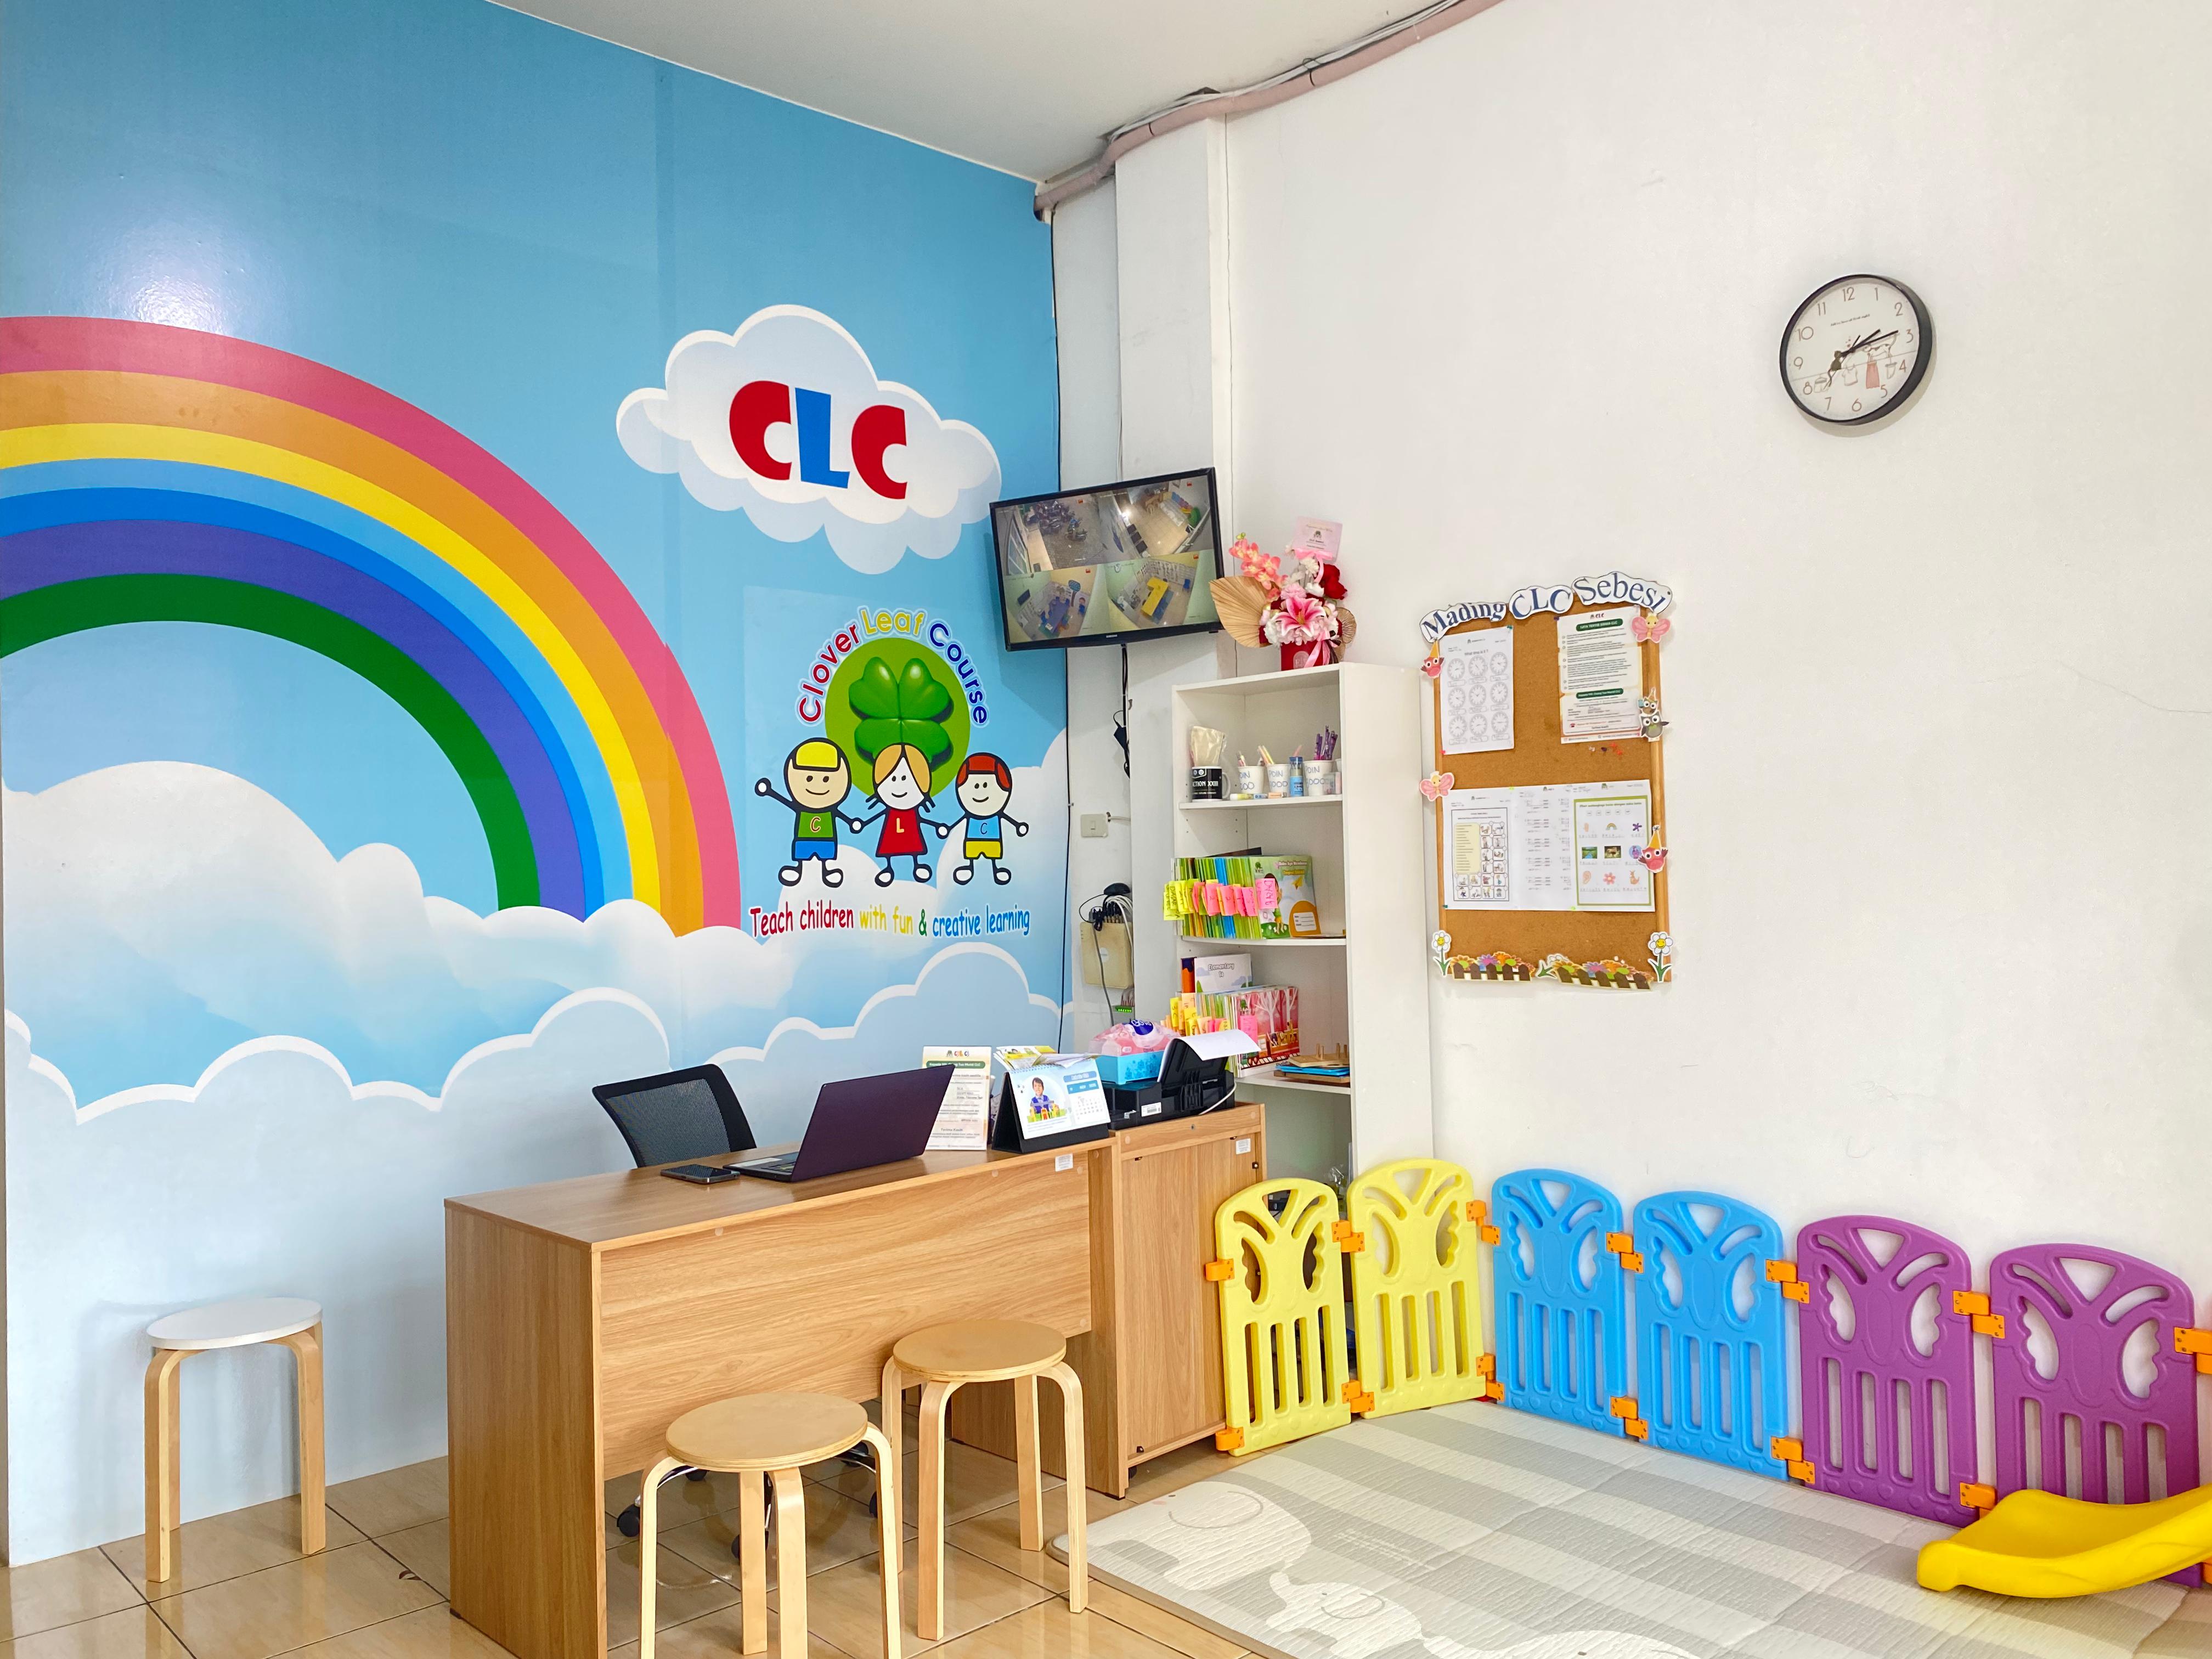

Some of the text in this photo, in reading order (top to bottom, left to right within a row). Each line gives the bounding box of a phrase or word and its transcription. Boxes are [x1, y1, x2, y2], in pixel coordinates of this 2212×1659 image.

[1842, 287, 1855, 301] 12
[1875, 288, 1878, 301] 1
[1817, 302, 1826, 316] 11
[1894, 302, 1903, 316] 2
[1797, 326, 1814, 341] 10
[1906, 329, 1913, 343] 3
[1793, 357, 1803, 369] 9
[1899, 359, 1907, 373] 4
[1803, 381, 1813, 394] 8
[1880, 385, 1888, 398] 5
[1825, 397, 1832, 410] 7
[1852, 398, 1861, 411] 6
[730, 381, 907, 499] CLC
[1423, 602, 1505, 638] Mading
[1513, 586, 1571, 618] CLC
[799, 610, 988, 724] Clover Leaf Course
[810, 816, 822, 832] C
[896, 818, 904, 833] L
[980, 822, 988, 835] C
[750, 900, 1030, 937] Teach children with fun & creative learning
